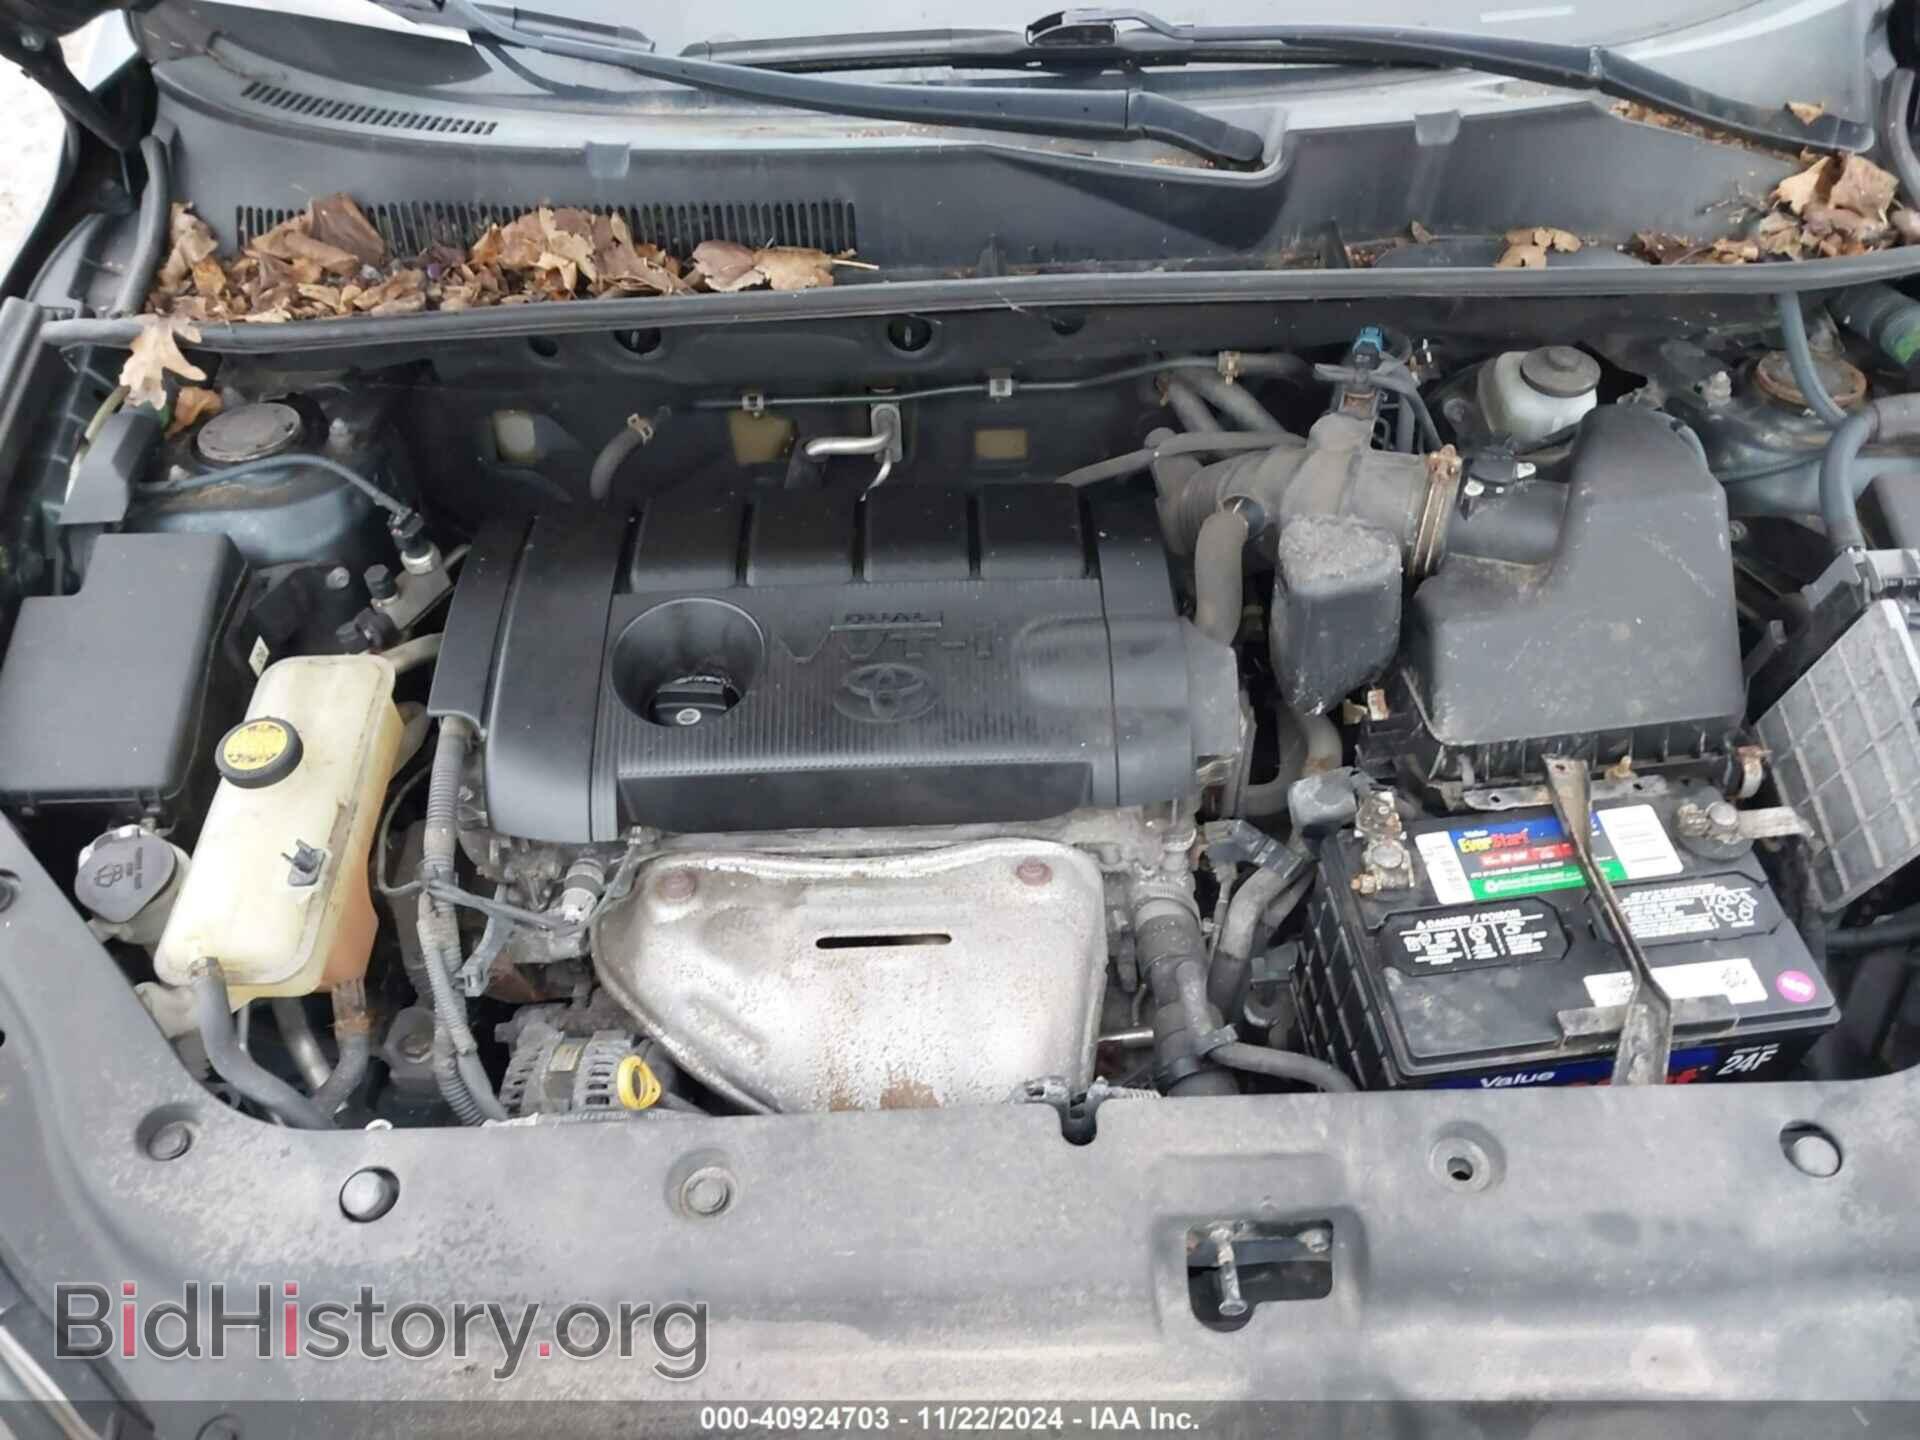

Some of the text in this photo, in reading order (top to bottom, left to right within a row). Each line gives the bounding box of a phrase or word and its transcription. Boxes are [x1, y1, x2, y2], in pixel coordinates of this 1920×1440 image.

[845, 611, 931, 624] DUAL
[1457, 827, 1529, 854] EverStart
[1716, 1048, 1779, 1076] 24F
[1480, 1069, 1556, 1088] Value
